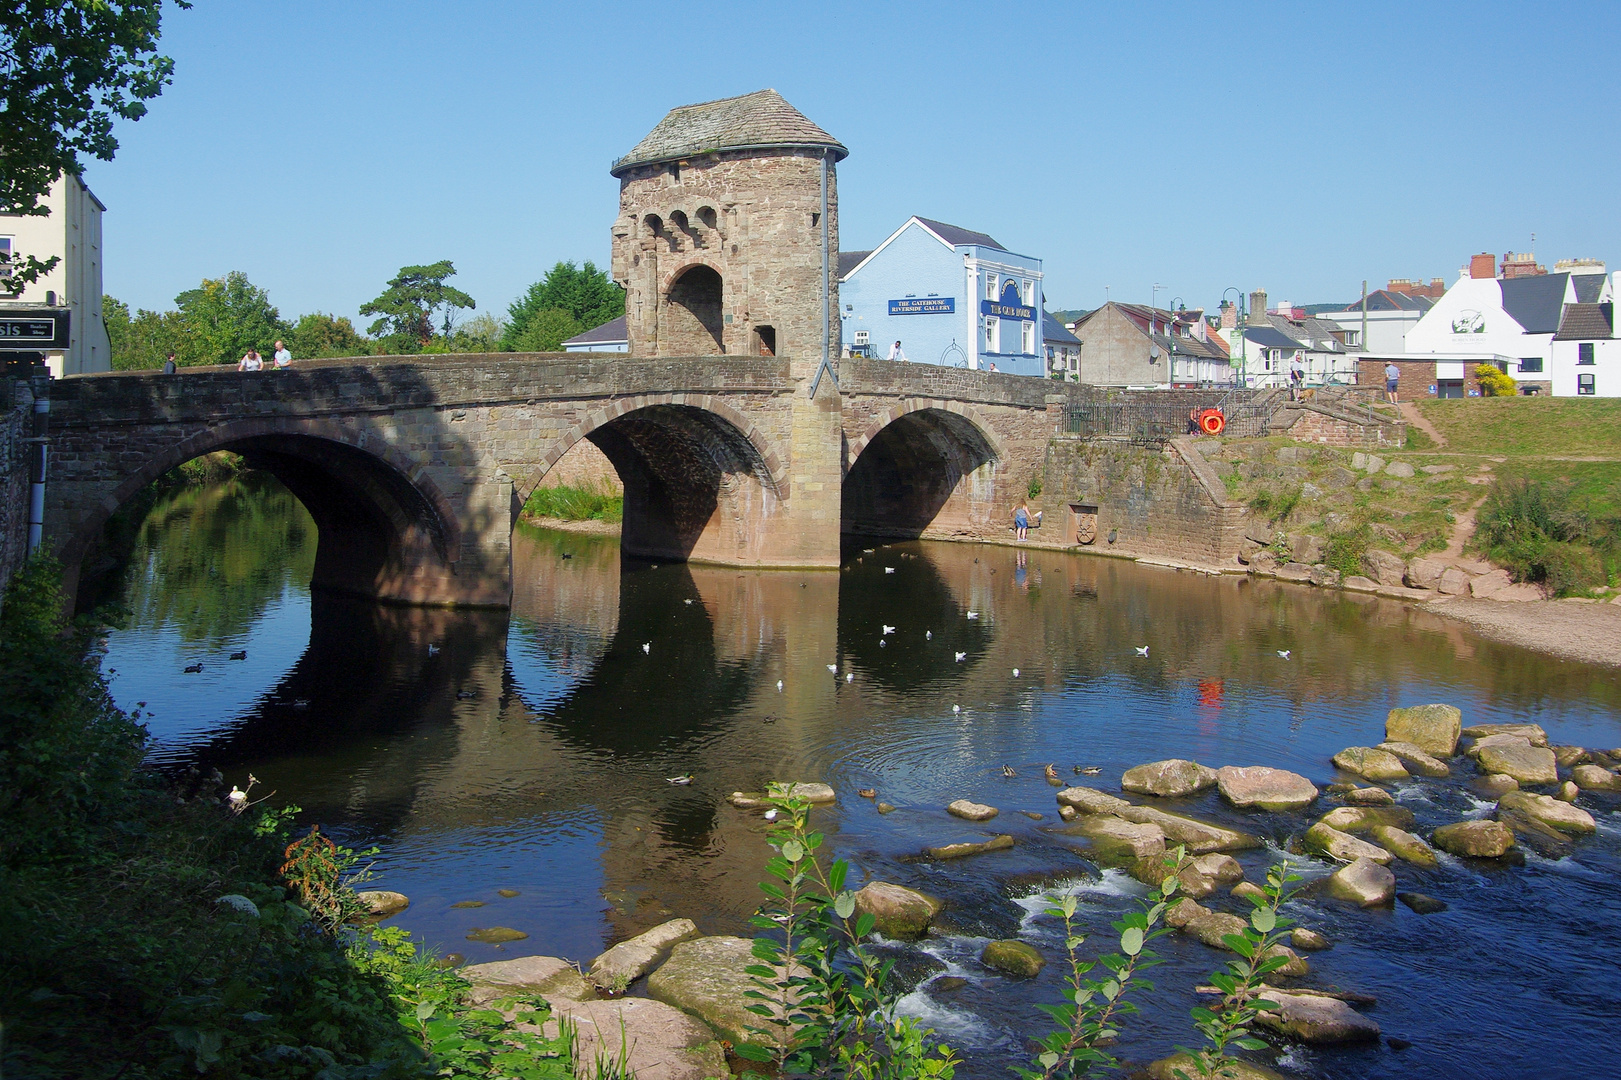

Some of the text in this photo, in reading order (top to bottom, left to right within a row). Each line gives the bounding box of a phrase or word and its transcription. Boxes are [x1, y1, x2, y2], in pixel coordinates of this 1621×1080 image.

[991, 304, 1031, 318] THE GATE HOUSE
